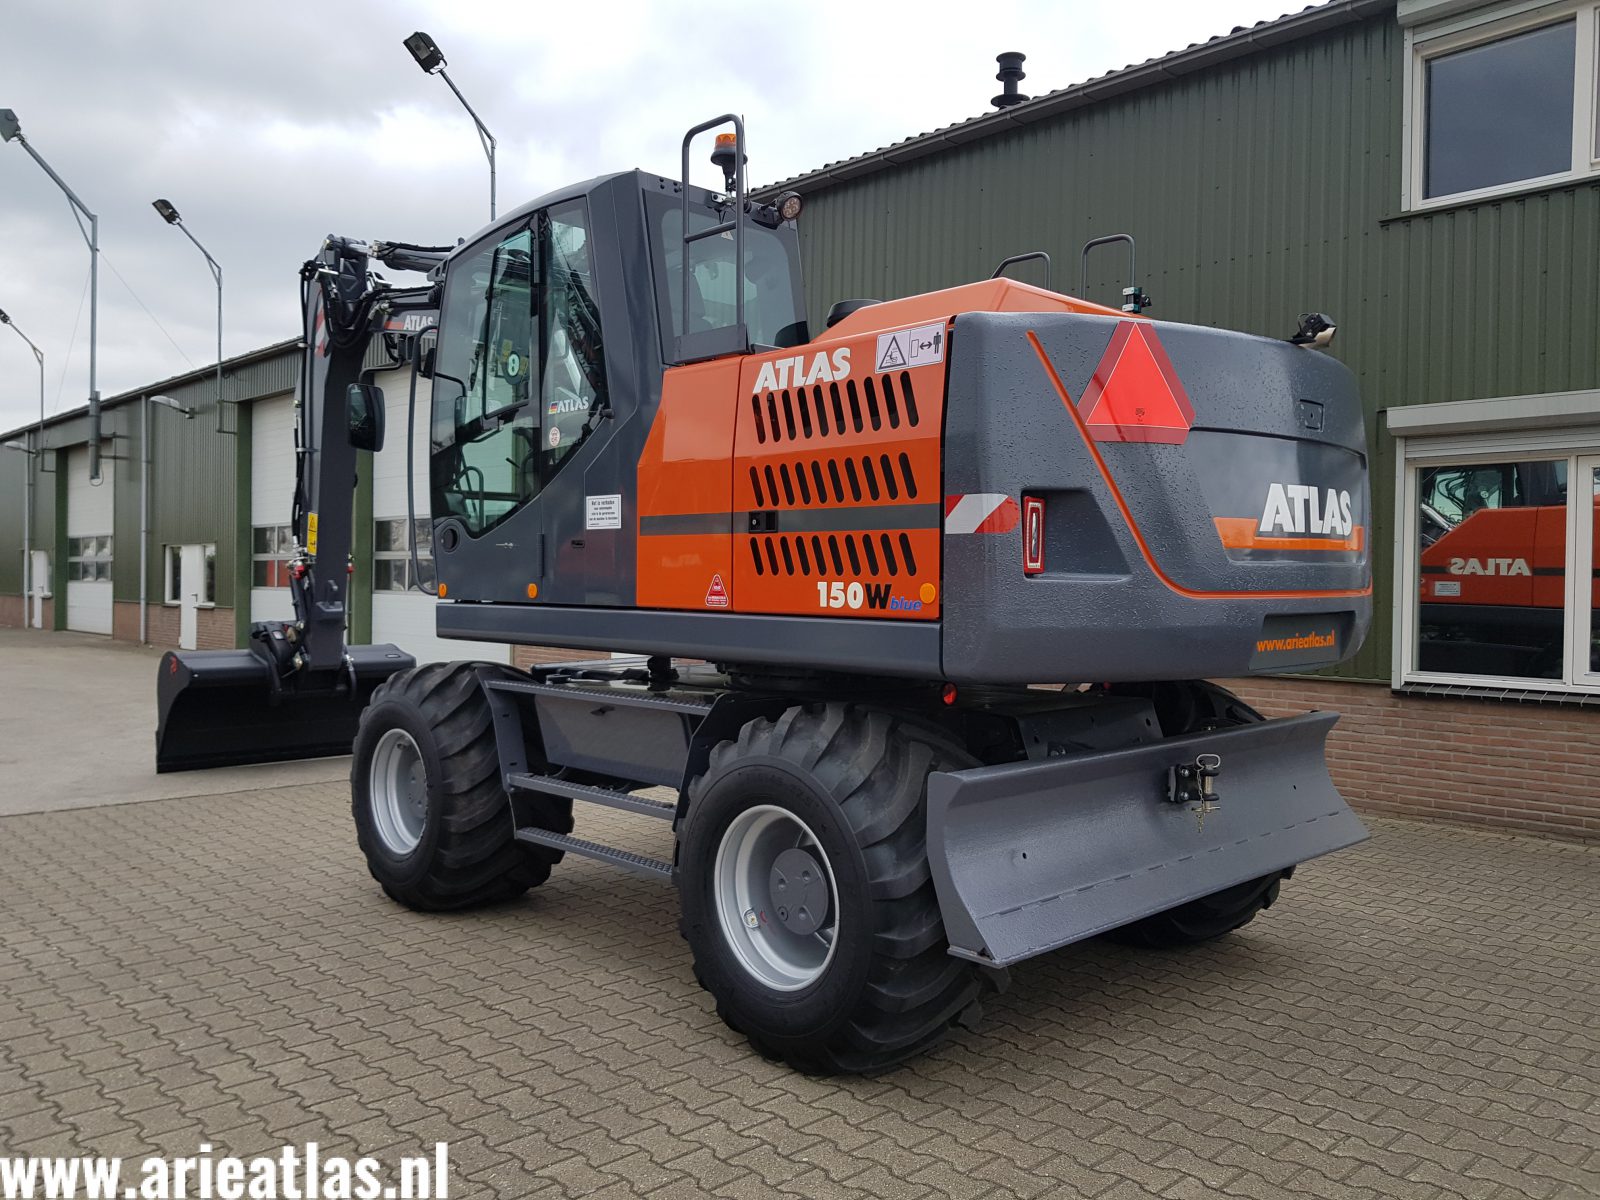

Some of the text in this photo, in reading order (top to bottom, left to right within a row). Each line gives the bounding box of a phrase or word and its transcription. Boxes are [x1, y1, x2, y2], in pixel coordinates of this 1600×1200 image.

[404, 315, 434, 331] ATLAS
[752, 347, 851, 394] ATLAS
[557, 396, 589, 414] ATLAS
[1260, 483, 1353, 536] ATLAS
[890, 596, 922, 610] blue
[1257, 628, 1335, 652] www.arieatlas.nl
